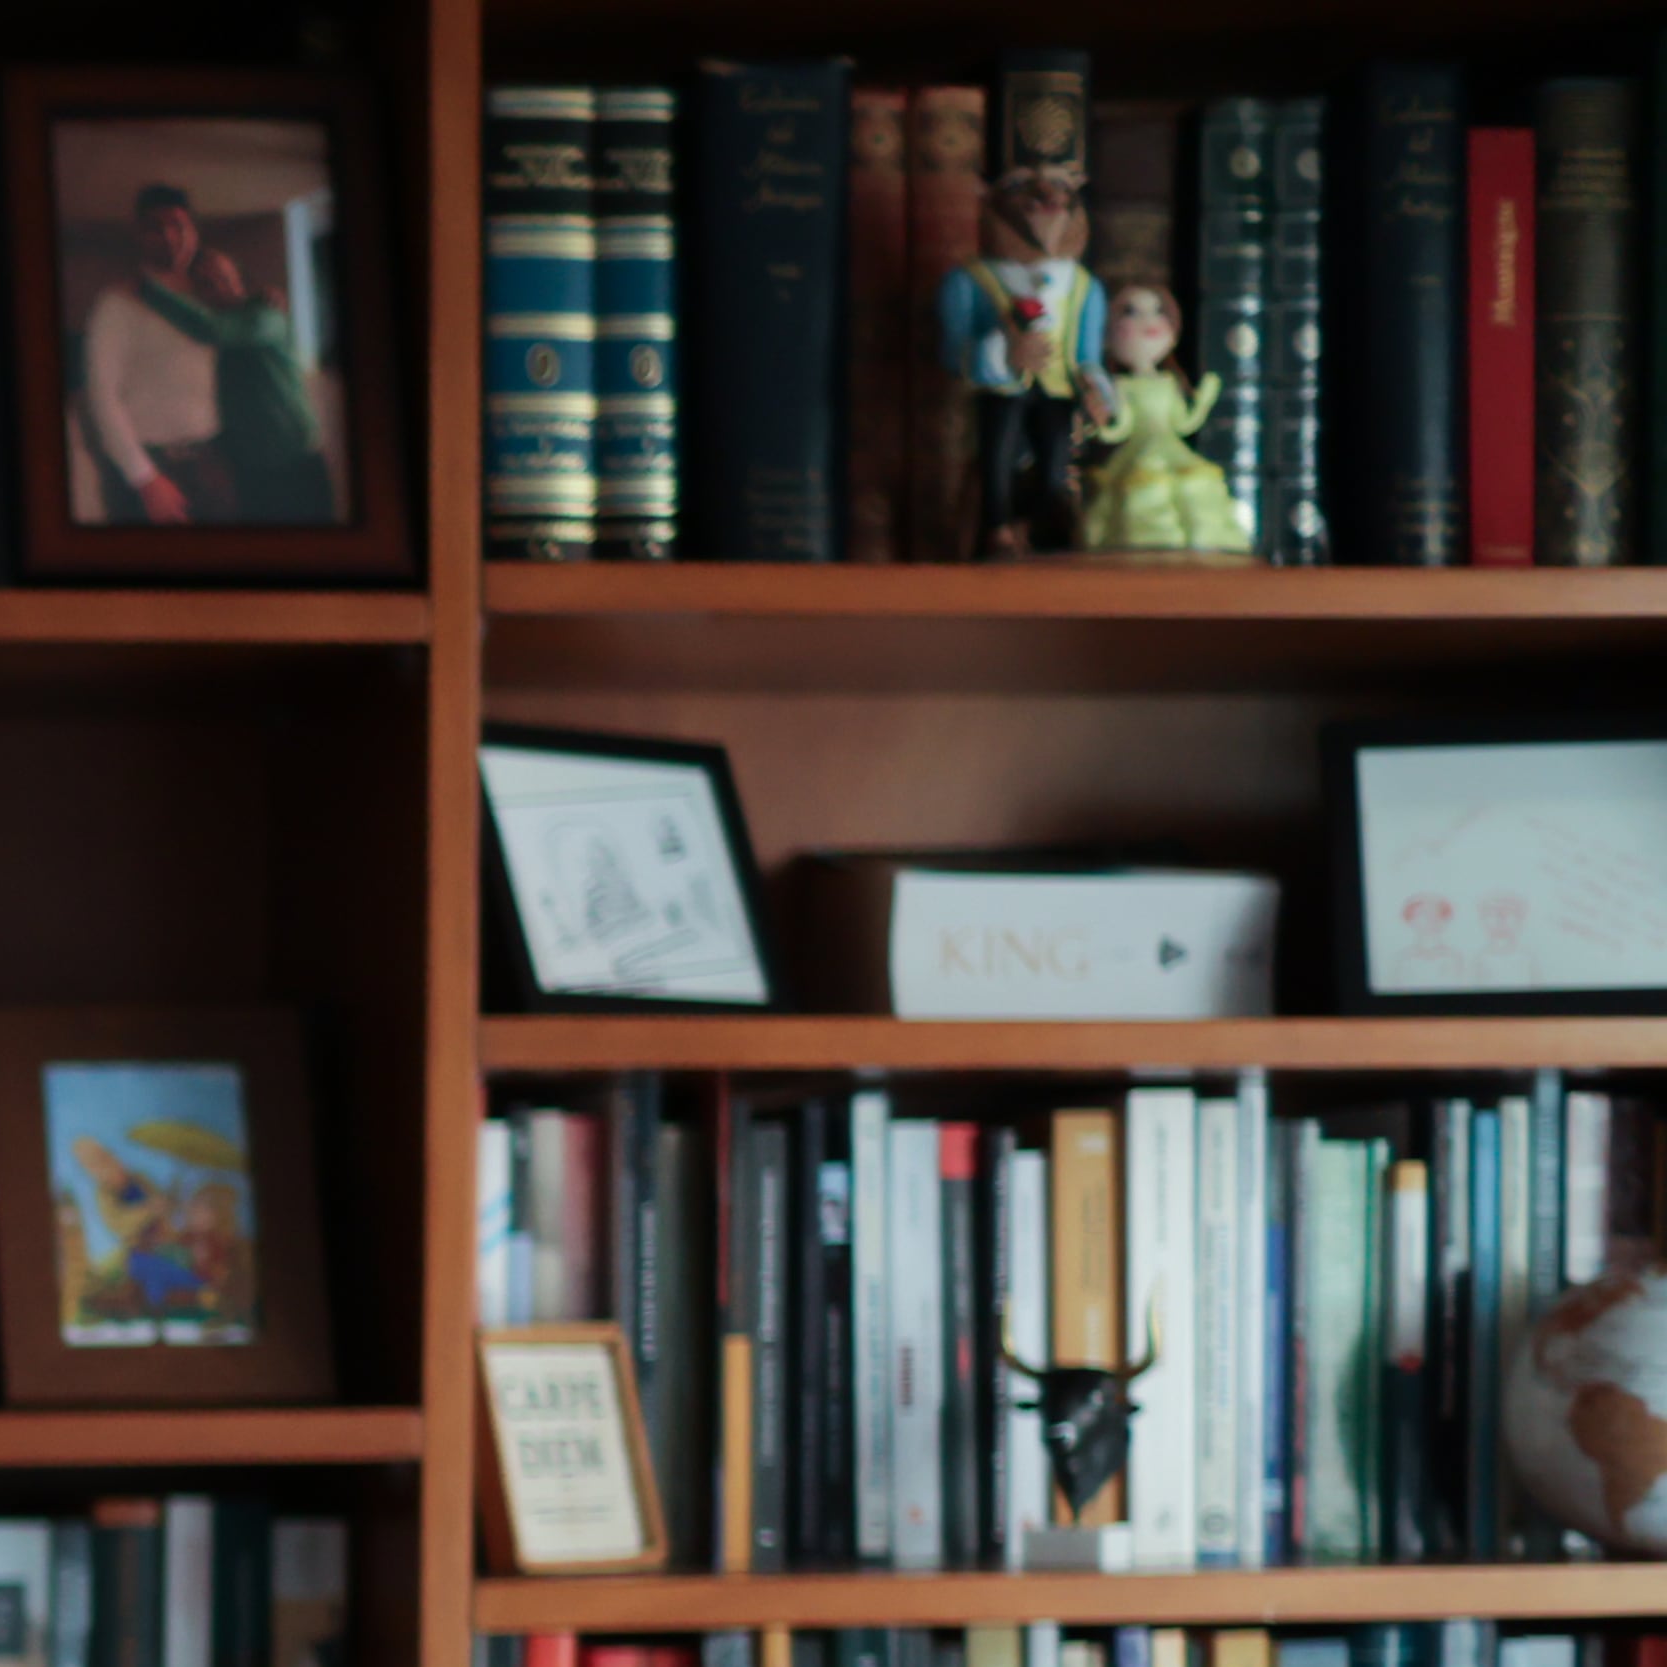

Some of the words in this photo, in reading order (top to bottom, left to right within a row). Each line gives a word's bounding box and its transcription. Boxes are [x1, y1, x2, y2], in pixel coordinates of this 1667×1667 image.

[938, 926, 1091, 982] KING
[499, 1374, 605, 1420] CARPE
[517, 1433, 607, 1479] DIEM
